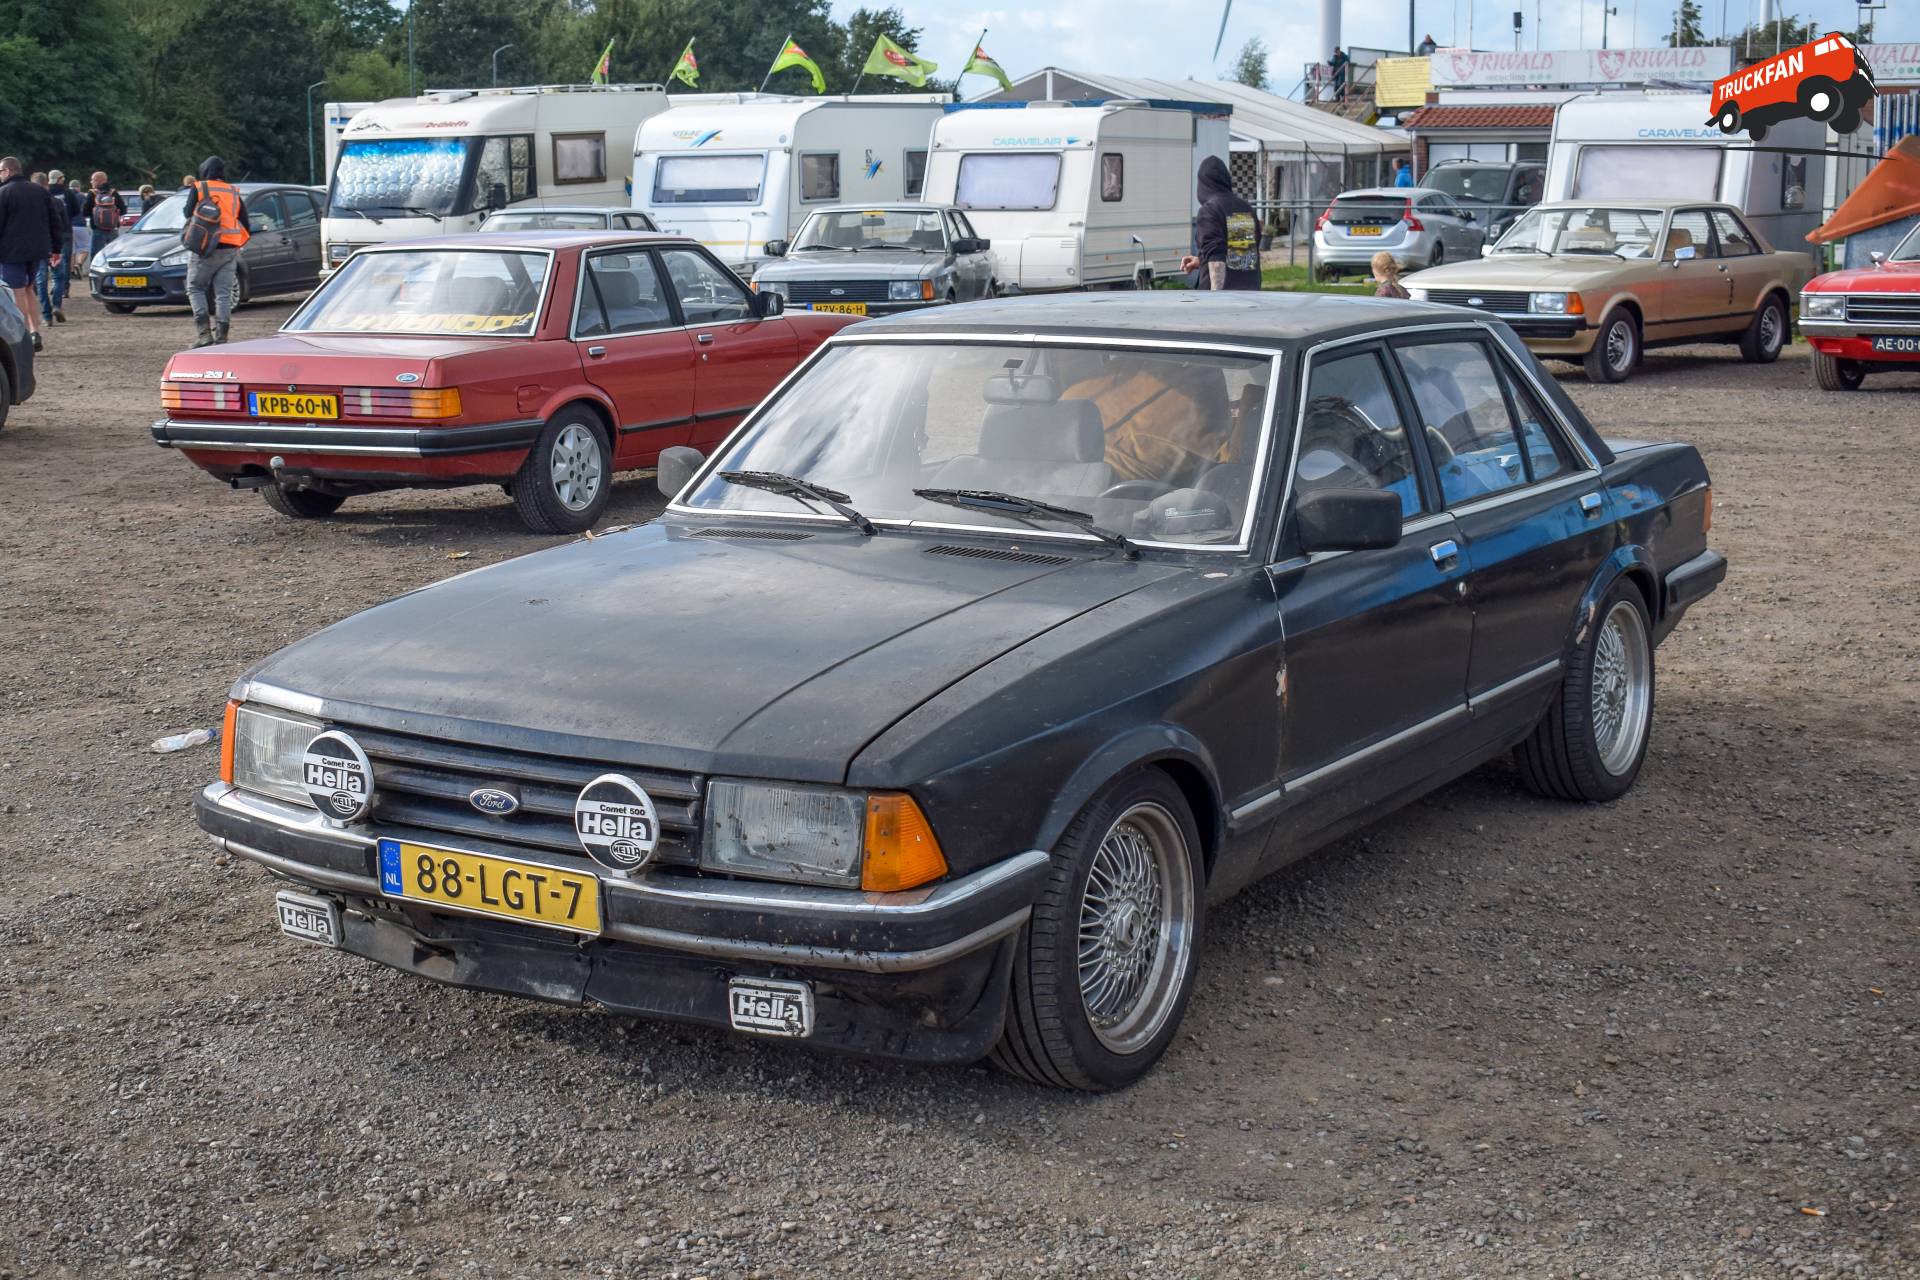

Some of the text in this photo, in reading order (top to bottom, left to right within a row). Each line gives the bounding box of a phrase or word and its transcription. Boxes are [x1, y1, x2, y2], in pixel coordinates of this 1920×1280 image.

[1480, 53, 1552, 70] RIWALD
[1628, 49, 1706, 68] RIWALD
[991, 136, 1061, 146] CARAVELAIR
[1638, 128, 1722, 138] CARAVELAIR
[1875, 338, 1920, 351] AE-00-
[259, 396, 332, 415] KPB-60-N
[322, 757, 361, 770] Comet 500
[307, 764, 362, 793] Hella
[333, 796, 357, 809] HELLA
[479, 793, 506, 809] Ford
[600, 804, 646, 816] Comet 500
[582, 812, 647, 840] Hella
[613, 845, 641, 857] HELLA
[385, 872, 401, 886] NL
[416, 853, 583, 920] 88-LGT-7
[283, 907, 328, 934] Hella
[737, 994, 799, 1021] Hella
